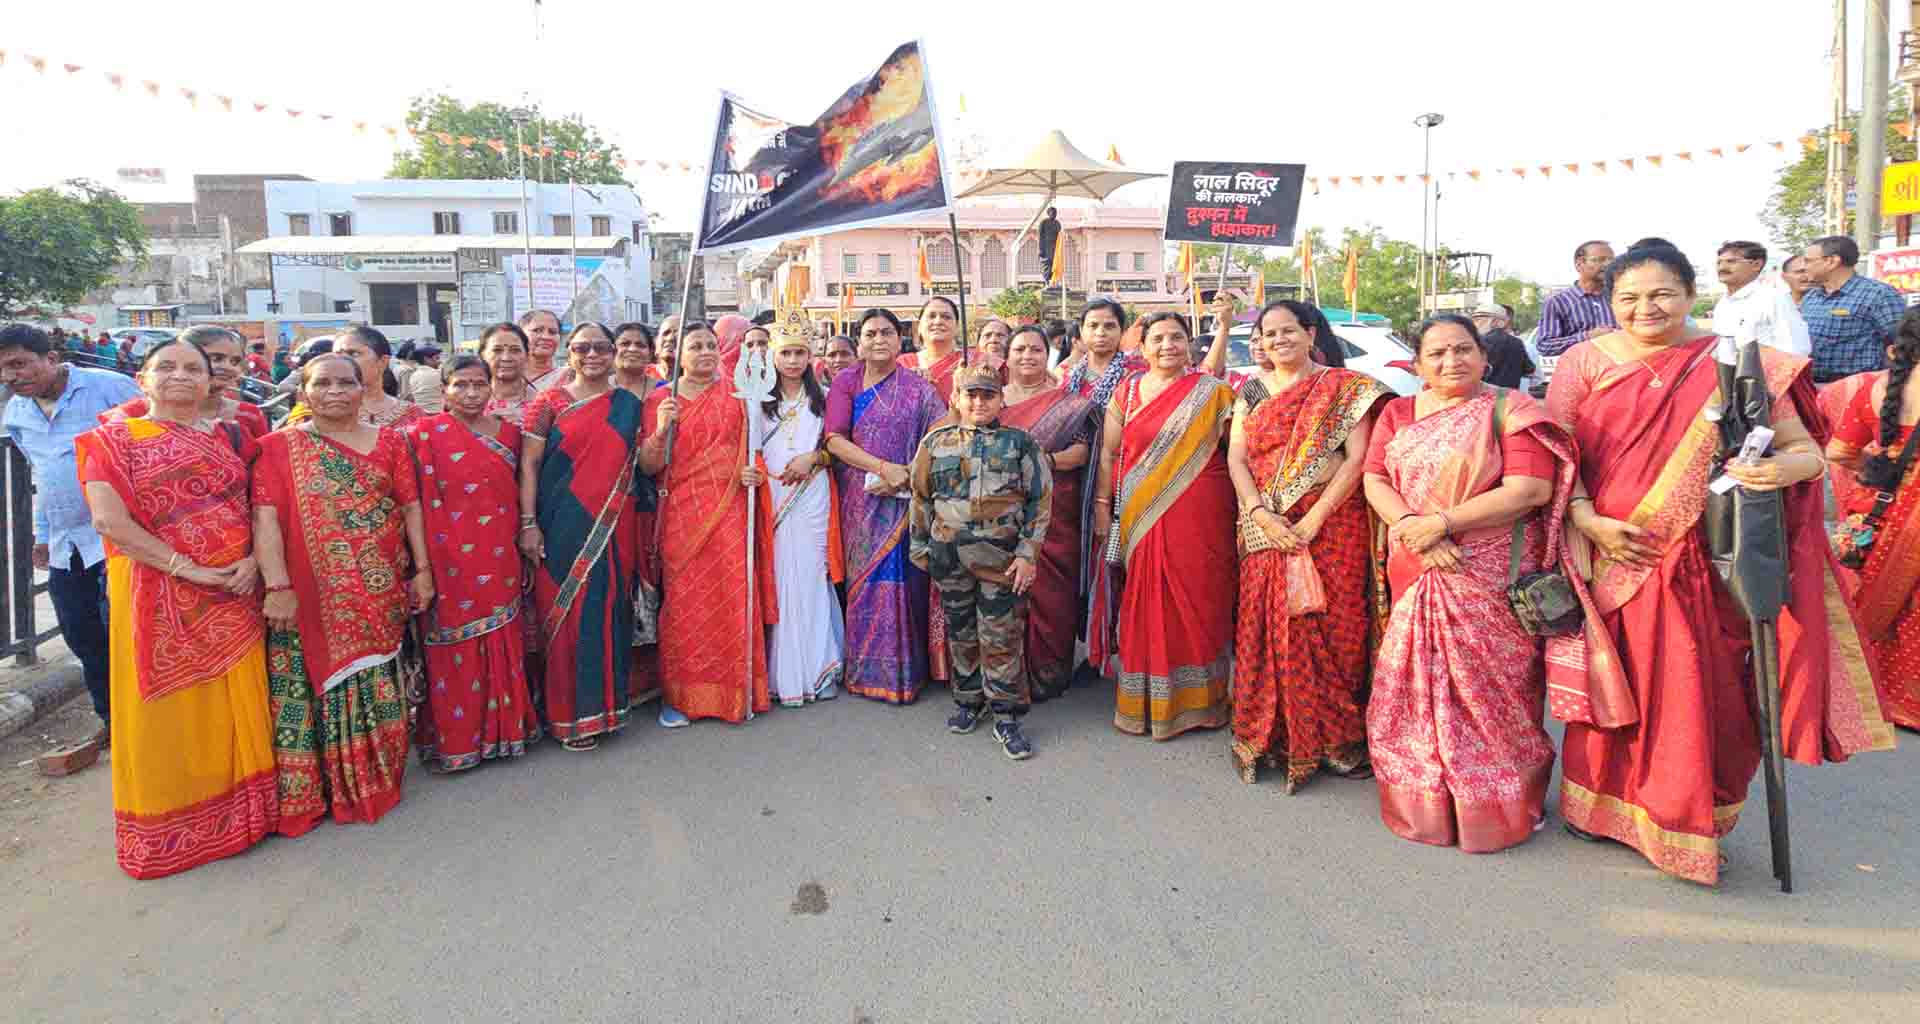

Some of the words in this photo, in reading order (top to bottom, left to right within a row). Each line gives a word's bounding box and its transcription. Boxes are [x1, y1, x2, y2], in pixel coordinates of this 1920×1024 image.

[1193, 174, 1232, 190] लाल
[1195, 189, 1212, 203] की
[1213, 192, 1262, 206] ललकार,
[1186, 207, 1230, 225] दुश्मन
[1233, 204, 1249, 222] में
[1210, 223, 1280, 239] हाहाकार!
